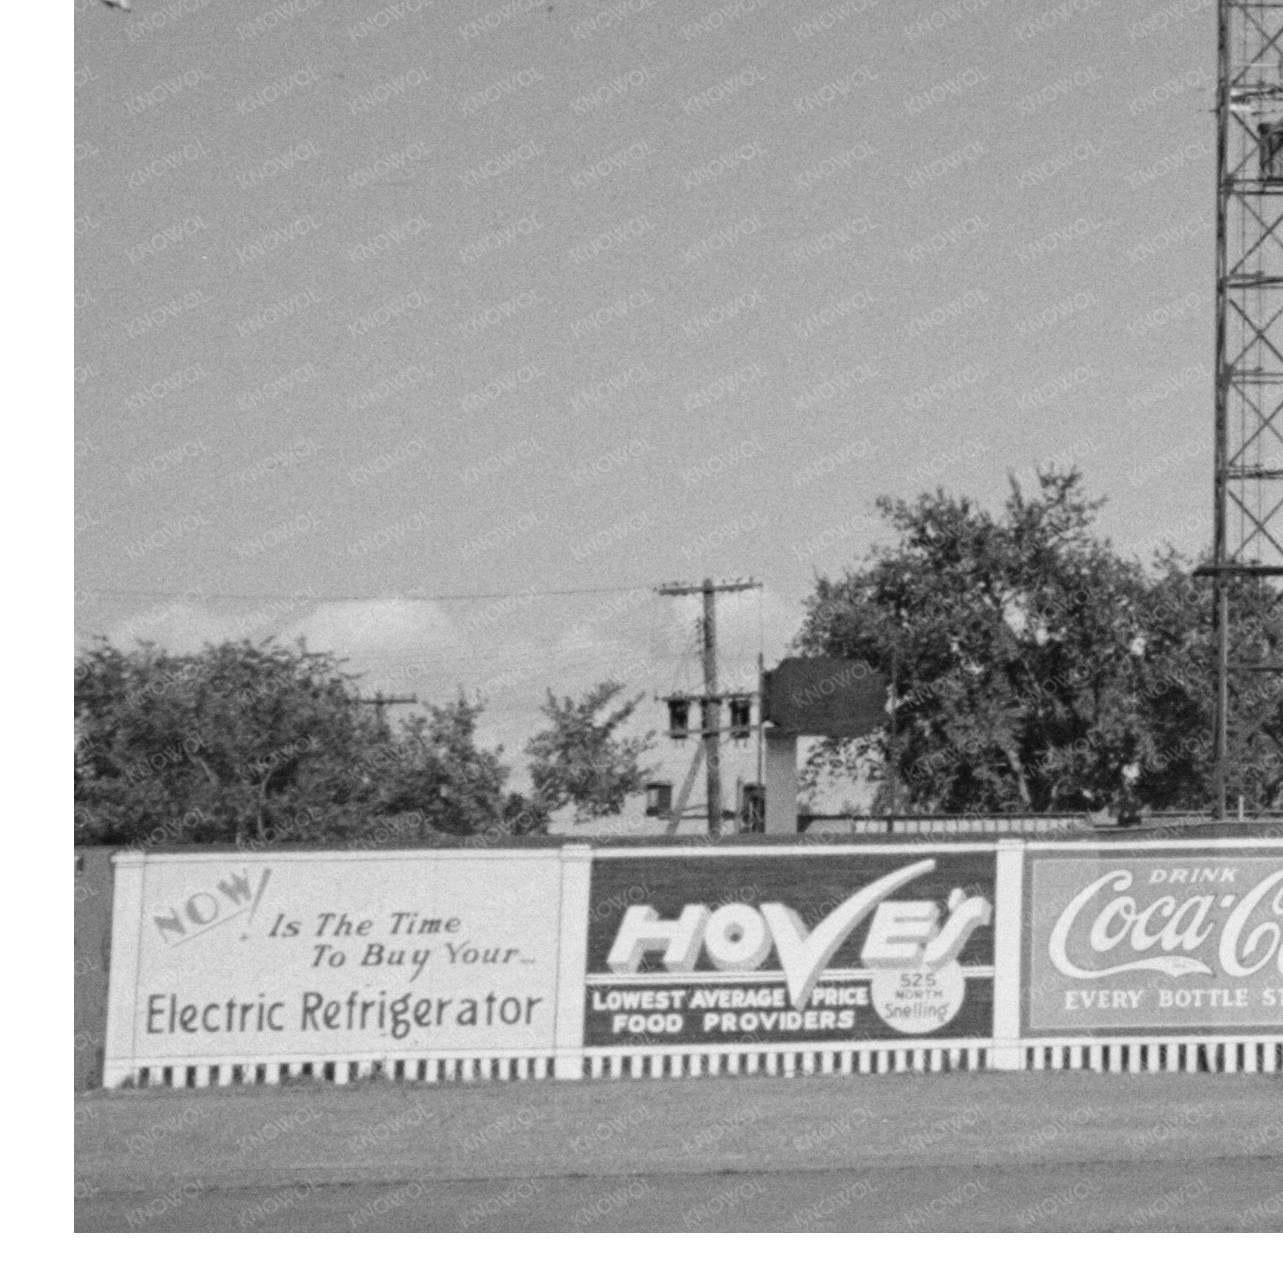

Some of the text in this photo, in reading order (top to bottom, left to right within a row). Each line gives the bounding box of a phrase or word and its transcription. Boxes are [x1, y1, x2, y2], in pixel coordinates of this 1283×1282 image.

[1149, 868, 1239, 883] DRINK
[153, 868, 272, 944] NOW!
[268, 912, 462, 939] Is The Time
[311, 944, 346, 969] To
[360, 944, 430, 982] Buy
[900, 972, 937, 987] 525
[593, 986, 869, 1011] LOWEST AVERAGE PRICE
[895, 988, 943, 1000] NORTH
[1065, 989, 1144, 1010] EVERY
[1159, 988, 1248, 1008] BOTTLE
[146, 990, 544, 1039] Electric Refrigerator
[613, 1010, 855, 1034] FOOD PROVIDERS
[884, 1002, 950, 1023] Snelling
